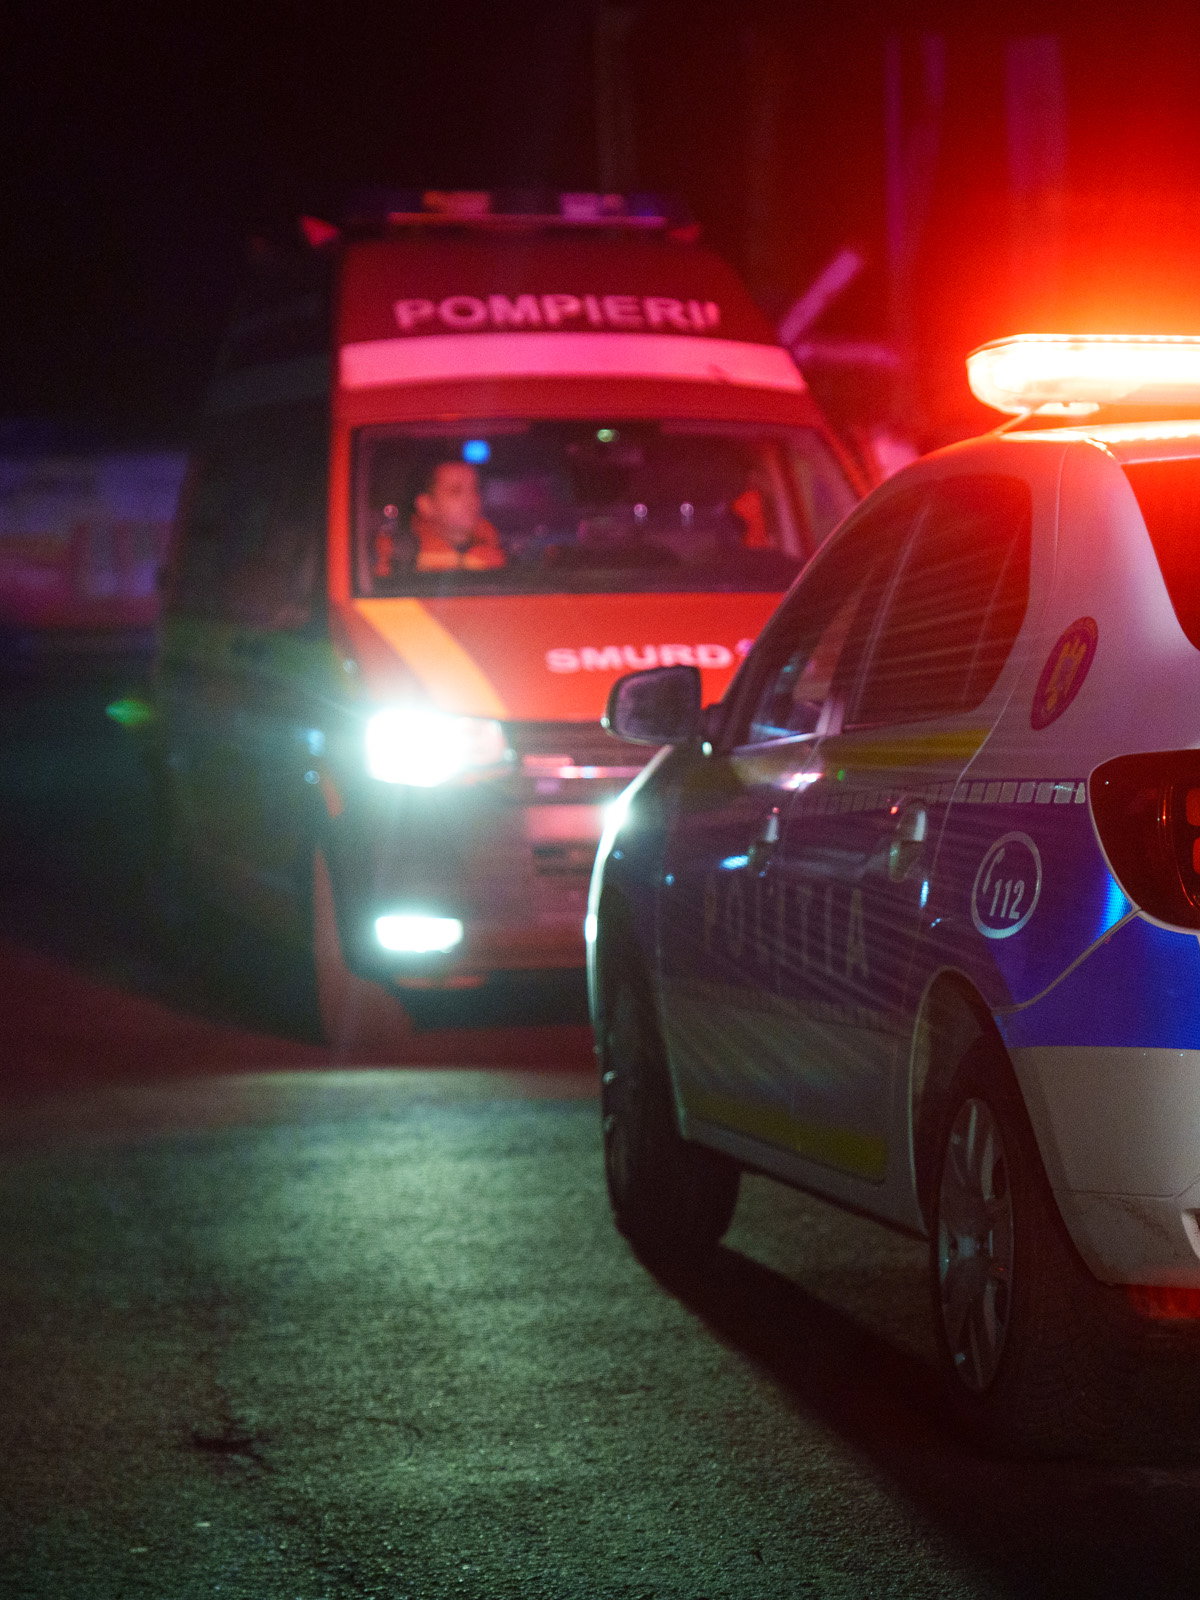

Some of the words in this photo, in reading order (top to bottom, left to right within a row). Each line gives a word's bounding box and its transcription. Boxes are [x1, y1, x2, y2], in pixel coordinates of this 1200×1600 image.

[394, 293, 721, 330] POMPIERII
[545, 644, 734, 673] SMURD
[989, 879, 1025, 919] 112
